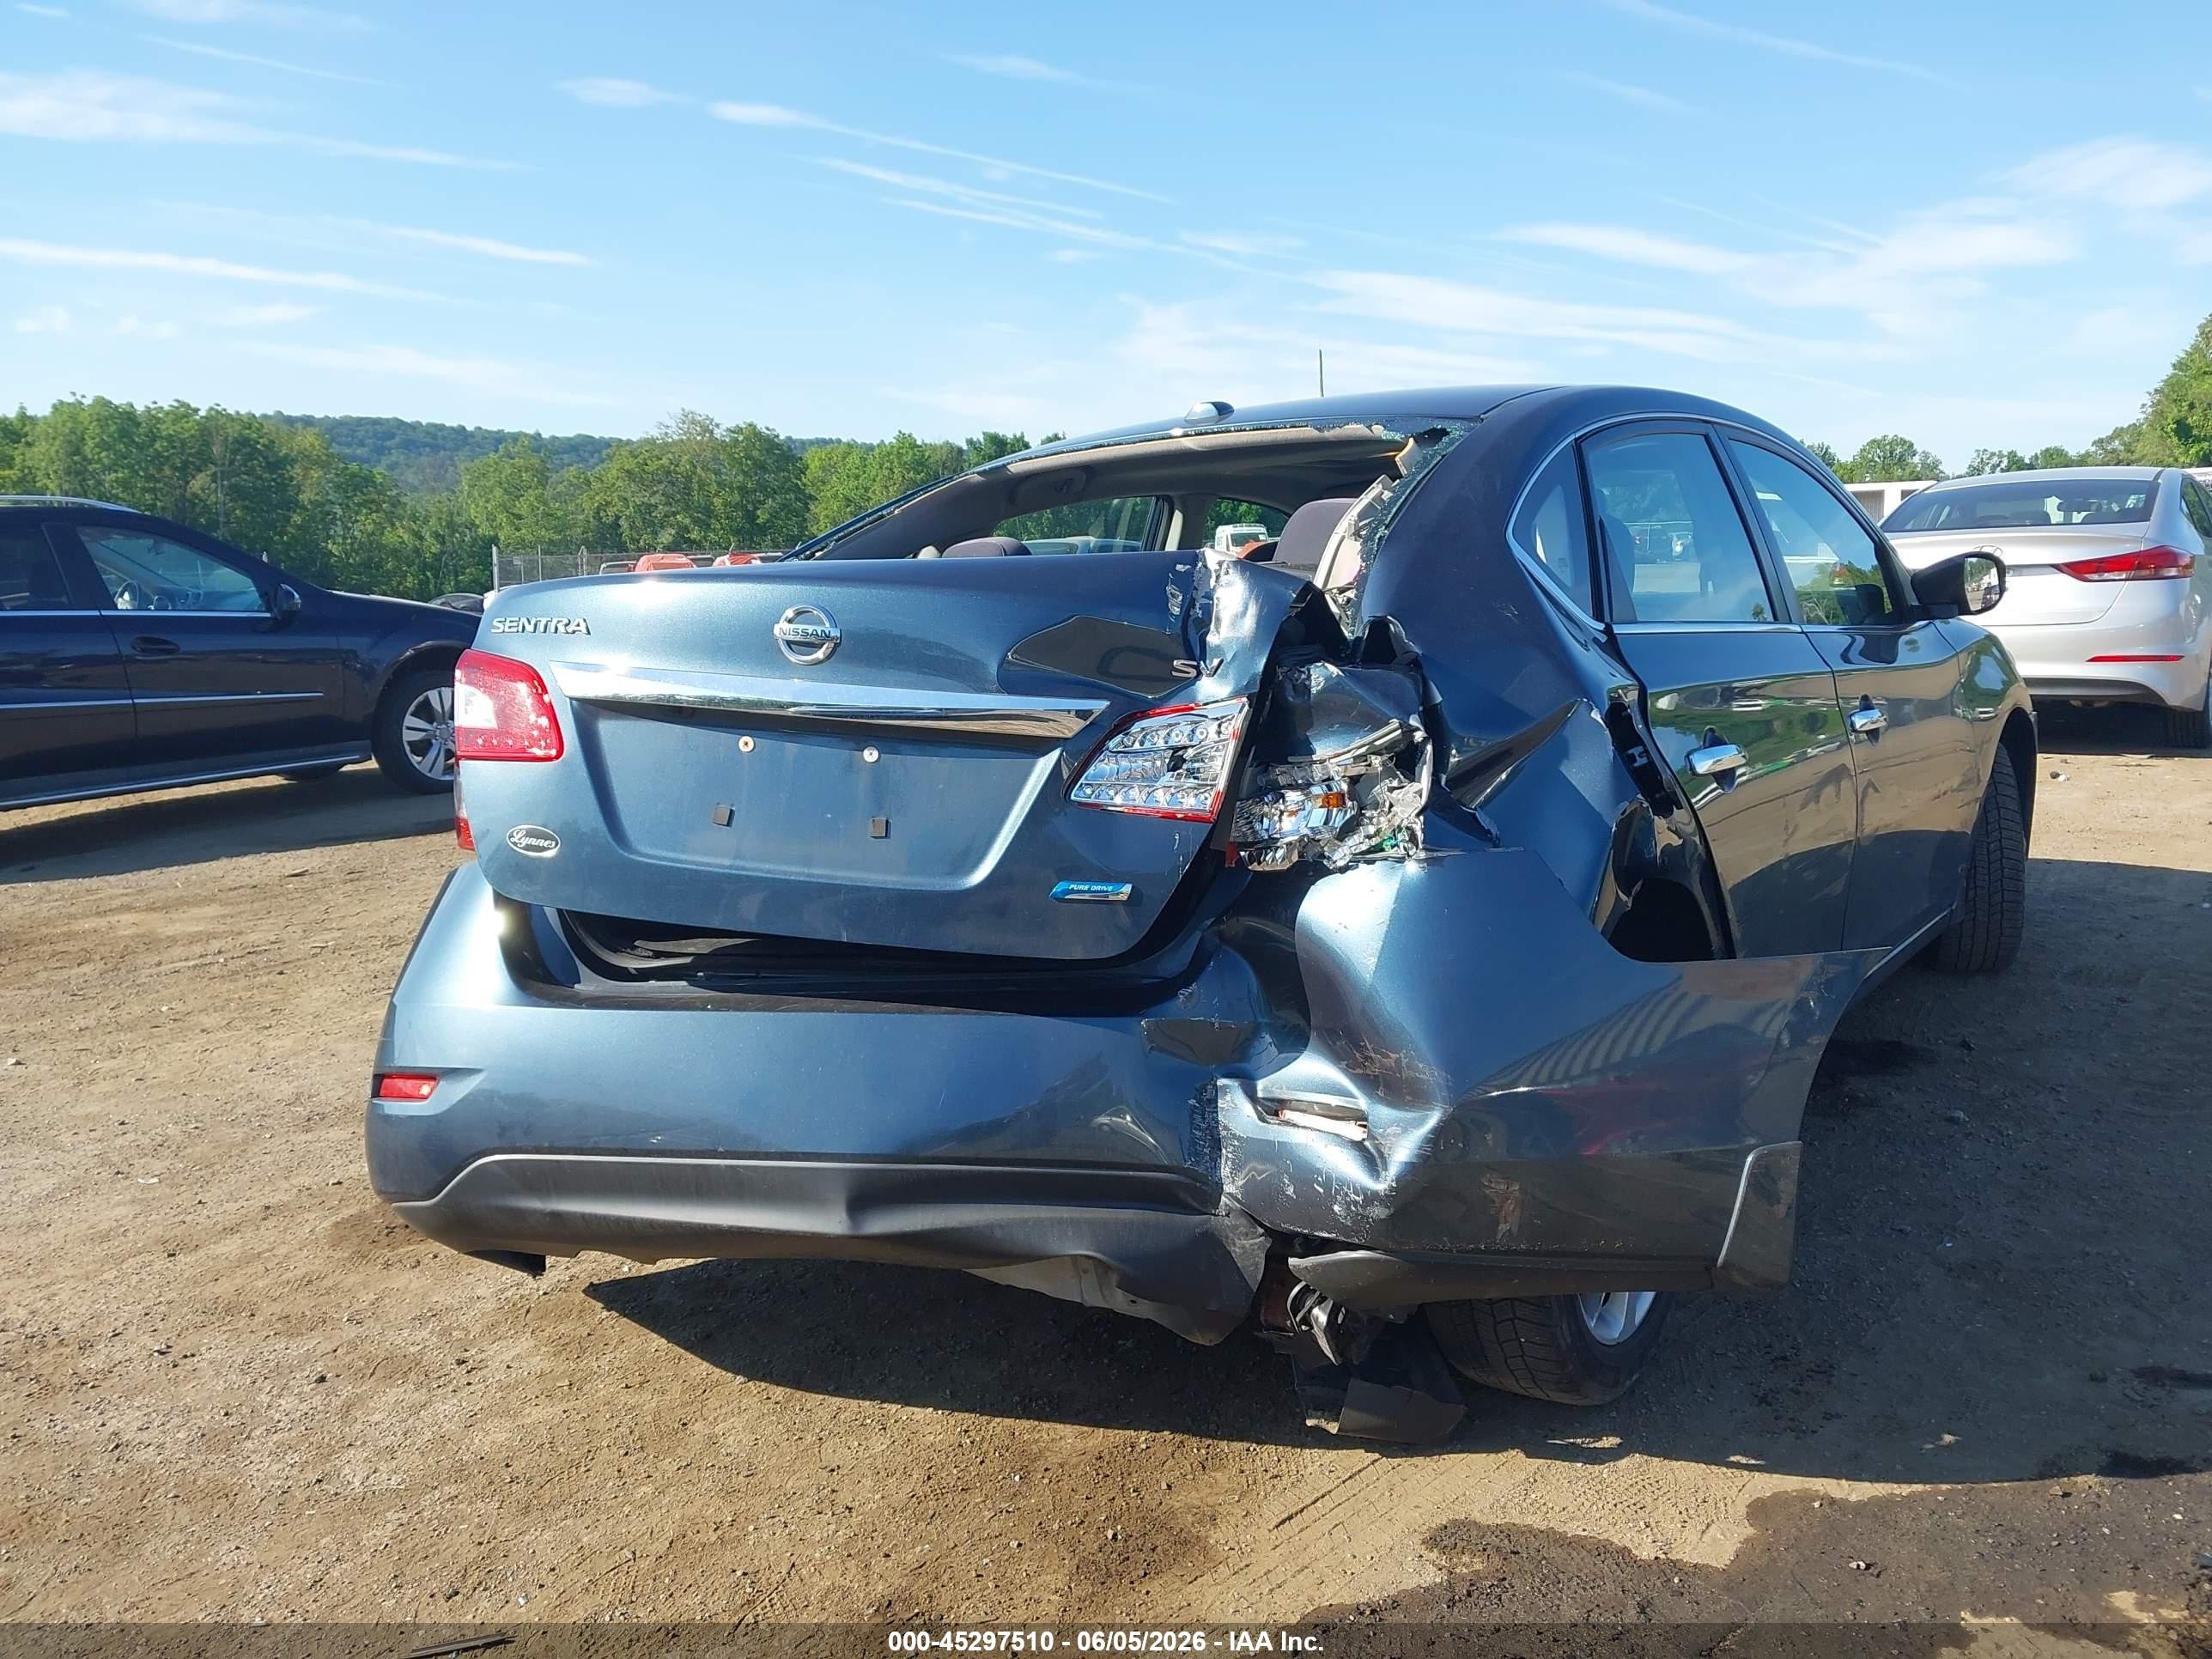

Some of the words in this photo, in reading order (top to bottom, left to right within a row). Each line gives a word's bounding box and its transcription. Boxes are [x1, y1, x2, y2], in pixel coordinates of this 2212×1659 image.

[490, 617, 591, 635] SENTRA
[779, 627, 831, 639] NISSAN
[1171, 657, 1224, 678] SV
[510, 830, 556, 848] Lynnes
